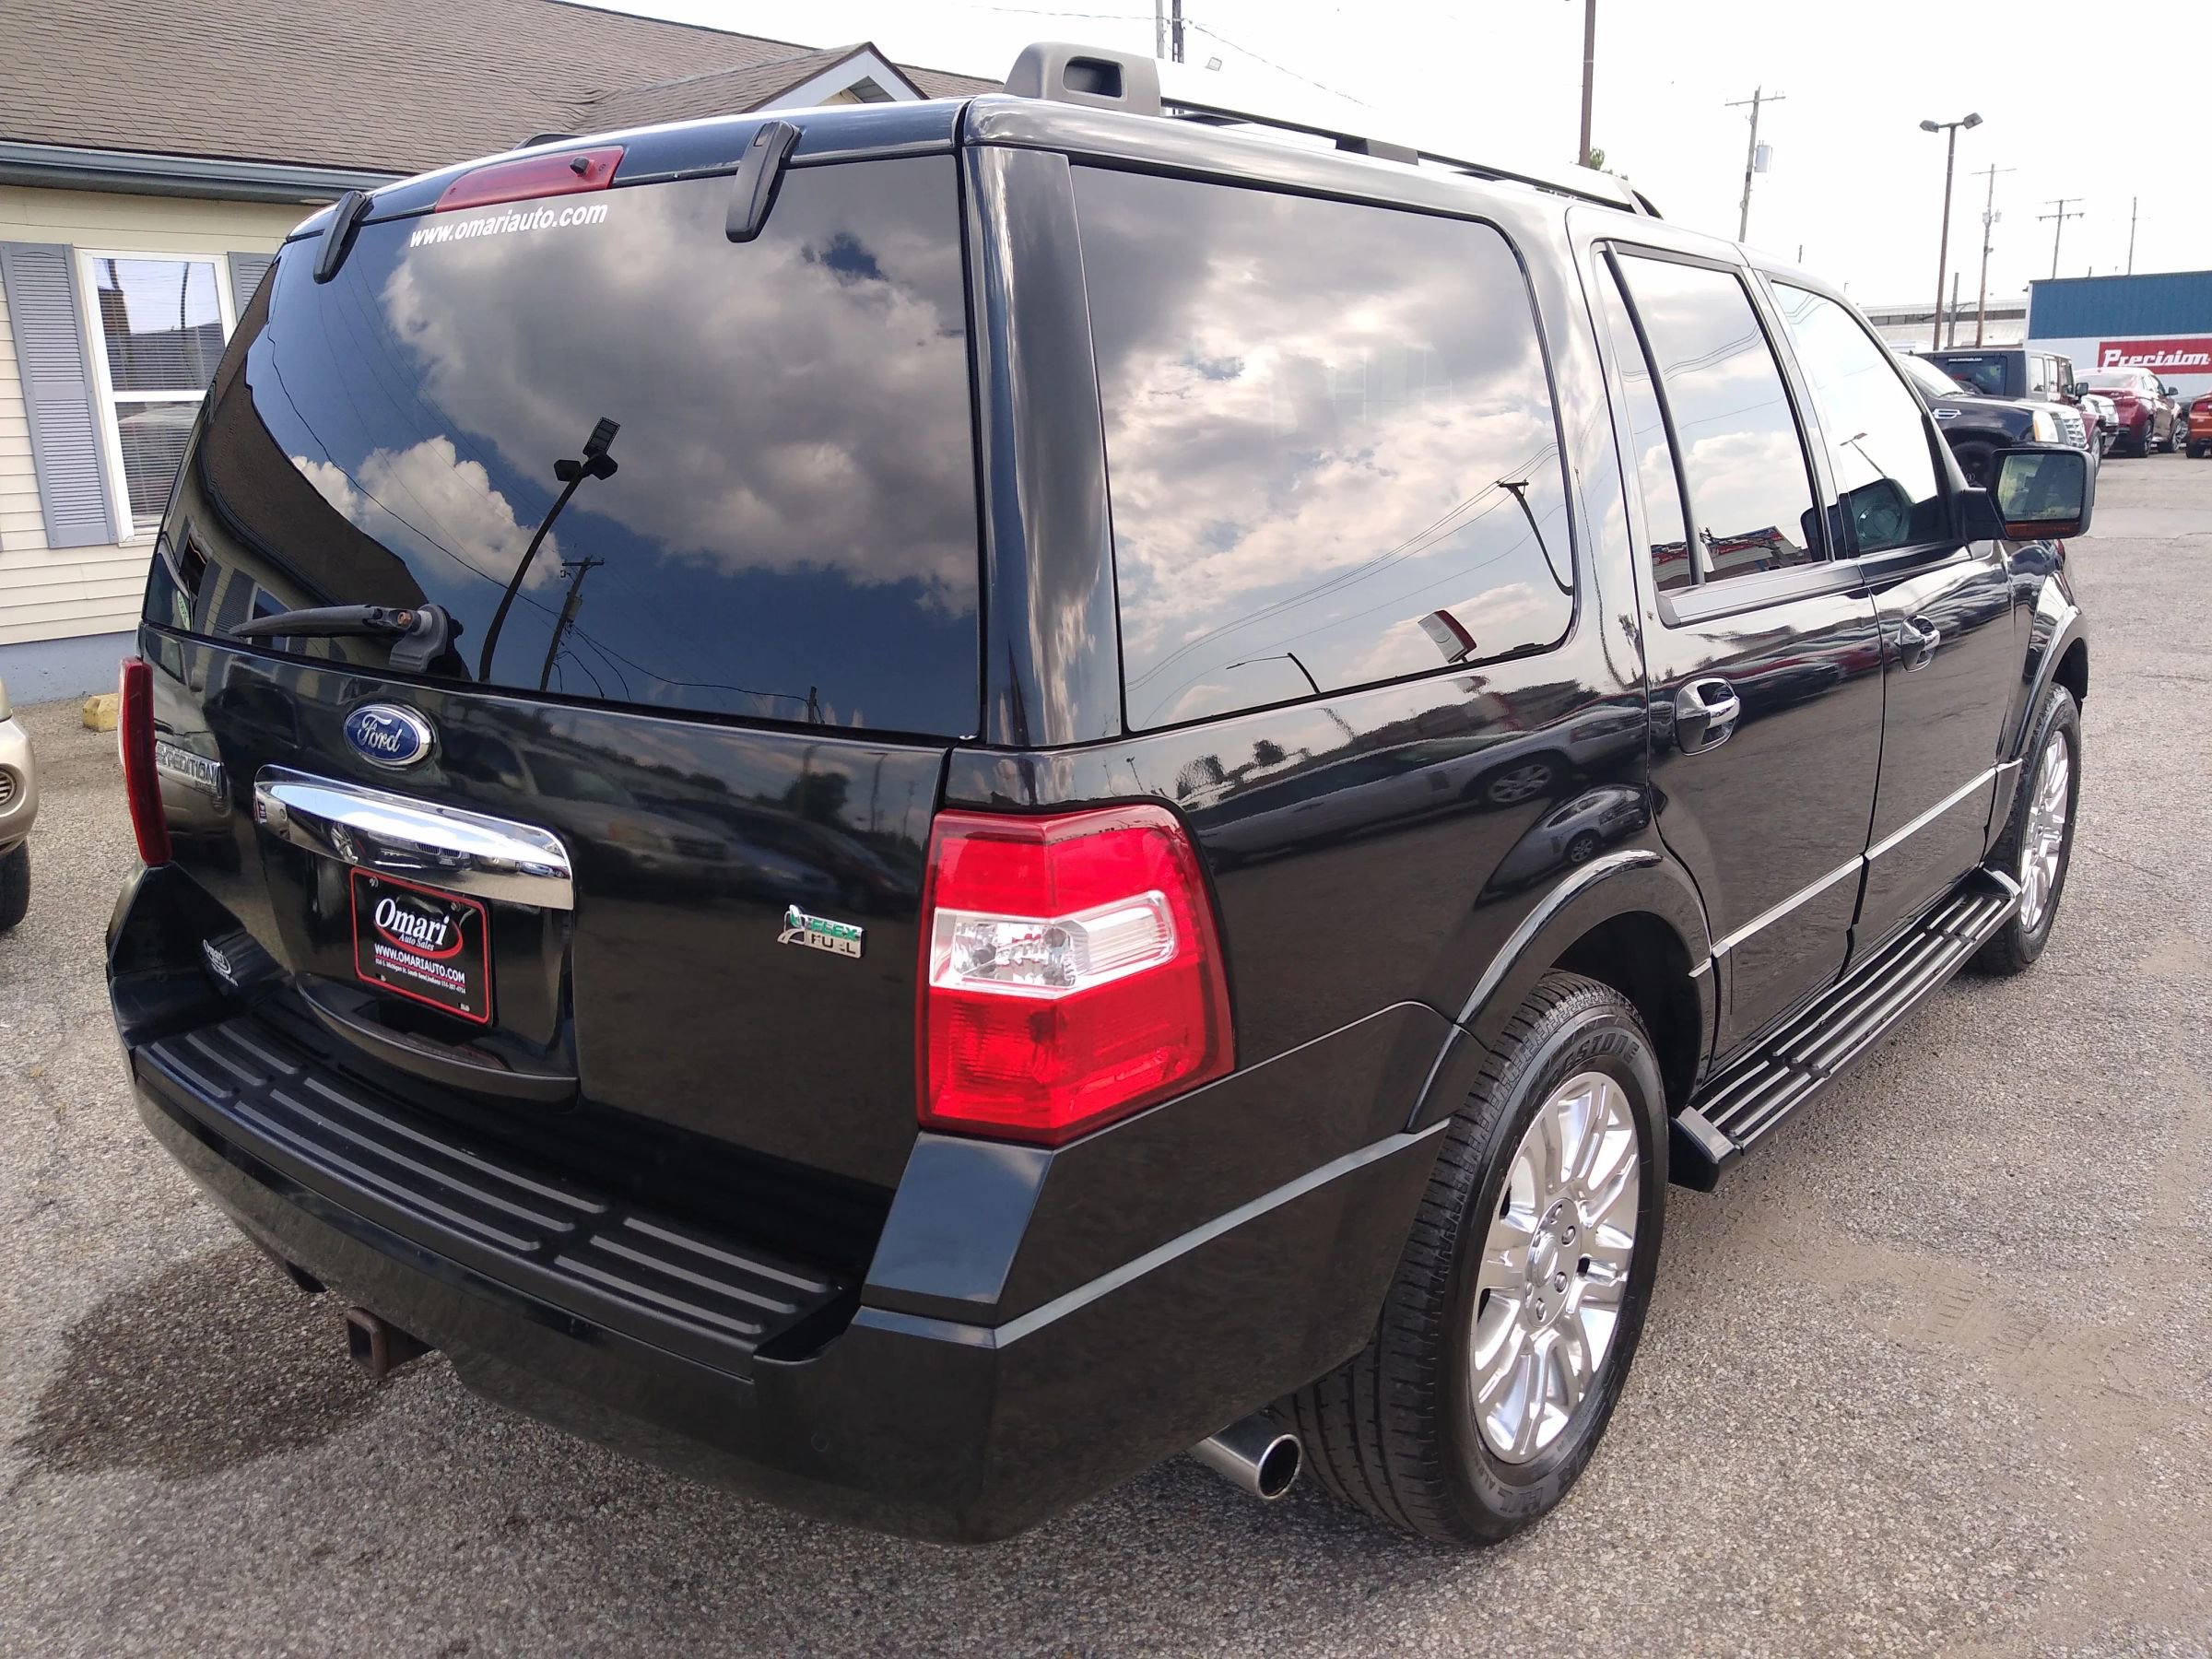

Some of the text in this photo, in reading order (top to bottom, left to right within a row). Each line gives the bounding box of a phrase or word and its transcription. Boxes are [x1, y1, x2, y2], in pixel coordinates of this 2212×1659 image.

[410, 205, 608, 248] www.omariauto.com
[2102, 348, 2209, 369] Precision
[357, 713, 403, 752] Ford
[375, 898, 450, 946] Omari
[811, 918, 857, 941] FLEX
[398, 933, 434, 951] Auto Sales
[374, 943, 465, 984] WWW.OMARIAUTO.COM
